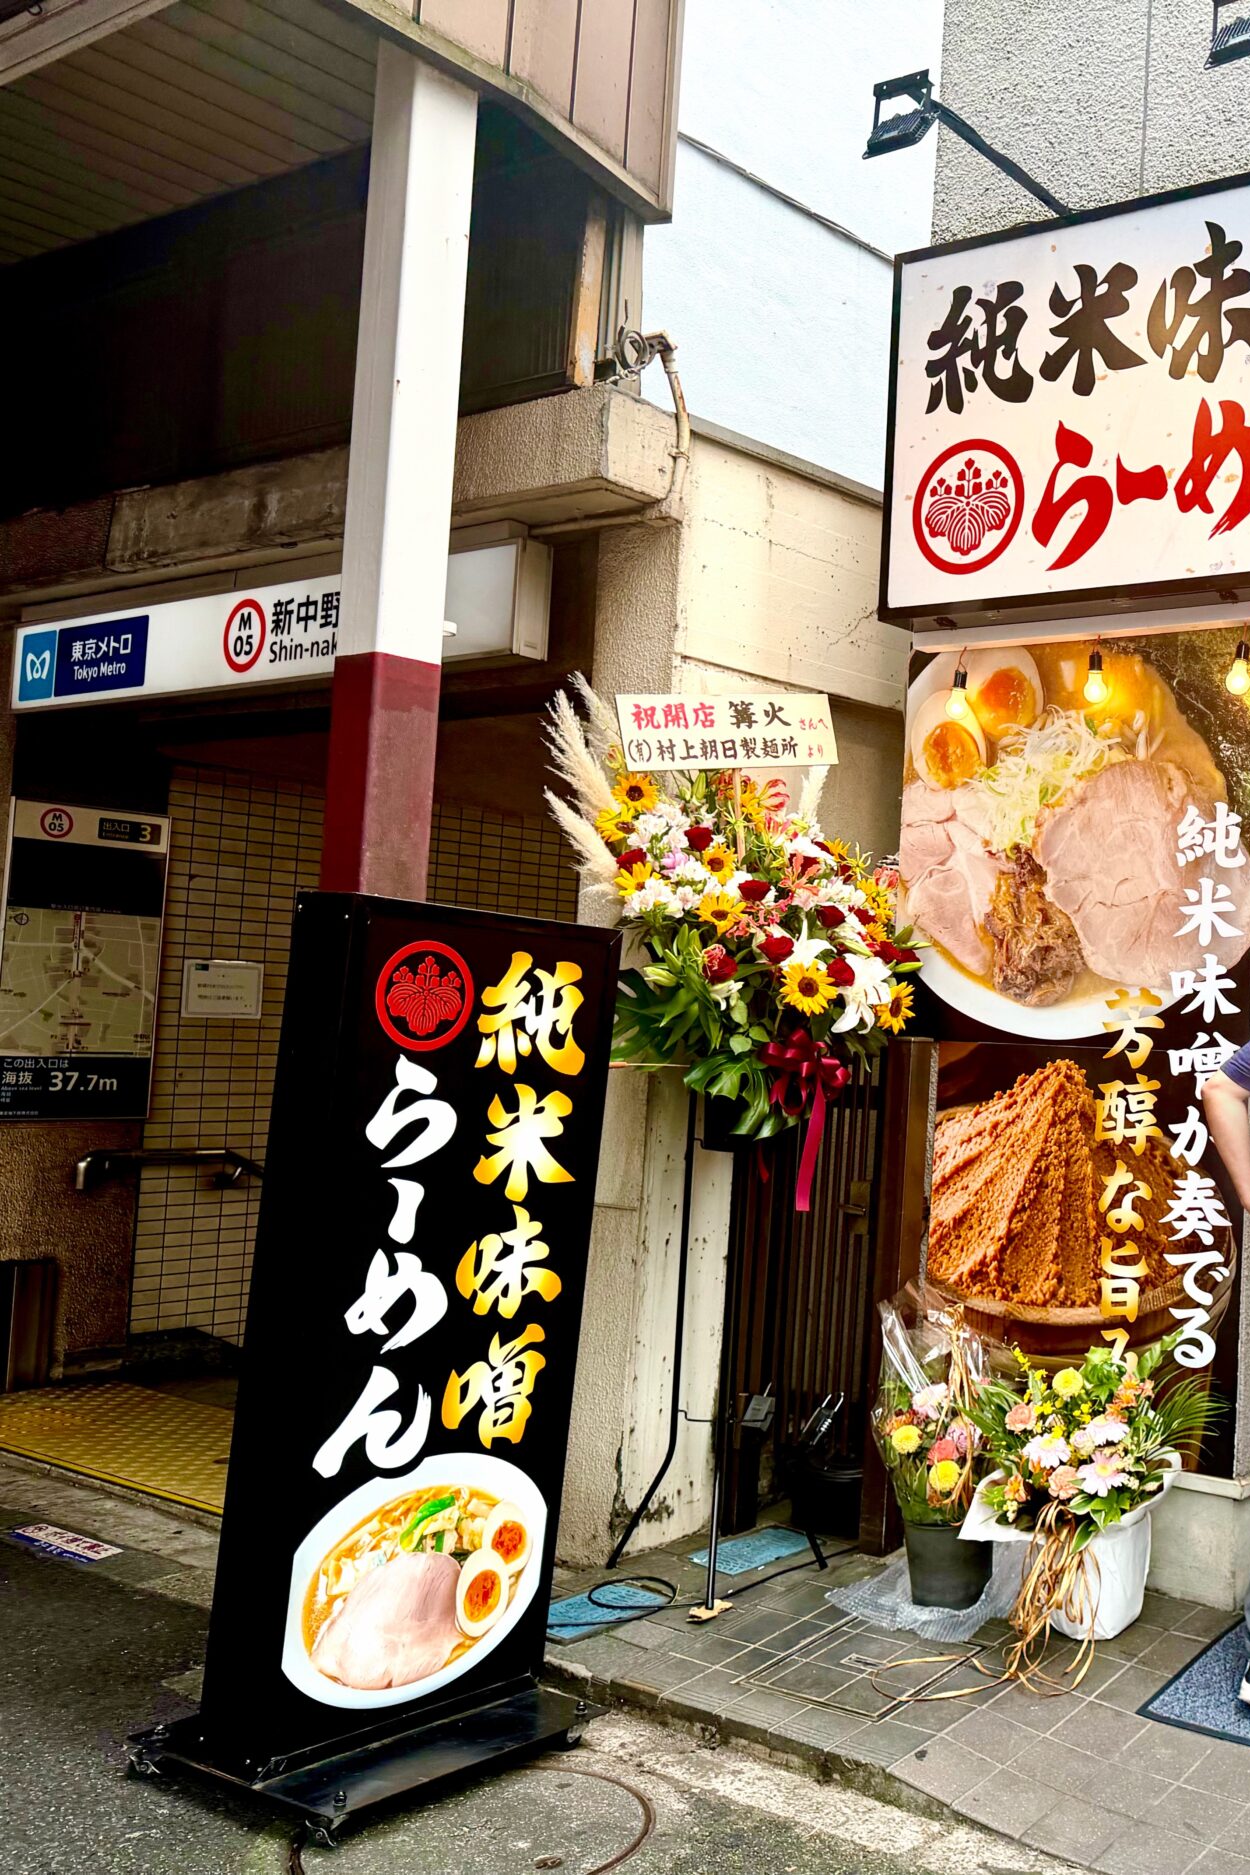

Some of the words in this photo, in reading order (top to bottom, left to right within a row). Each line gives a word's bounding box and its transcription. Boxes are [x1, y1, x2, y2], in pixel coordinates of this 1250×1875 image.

[238, 612, 251, 632] M
[270, 591, 340, 637] 新中野
[70, 633, 132, 662] 東京メトロ
[233, 635, 253, 657] 05
[74, 664, 98, 682] Tokyo
[100, 661, 126, 677] Metro
[631, 702, 716, 731] 祝開店
[728, 700, 792, 730] 篝火
[807, 743, 824, 759] より
[48, 822, 65, 833] 05
[51, 812, 63, 823] M
[102, 821, 131, 833] 出入口
[139, 824, 152, 842] 3
[3, 1058, 70, 1069] この出入口は
[1, 1070, 33, 1085] 海抜
[48, 1071, 118, 1091] 37.7m
[441, 951, 586, 1450] 純米味噌
[312, 1054, 458, 1479] らーめん
